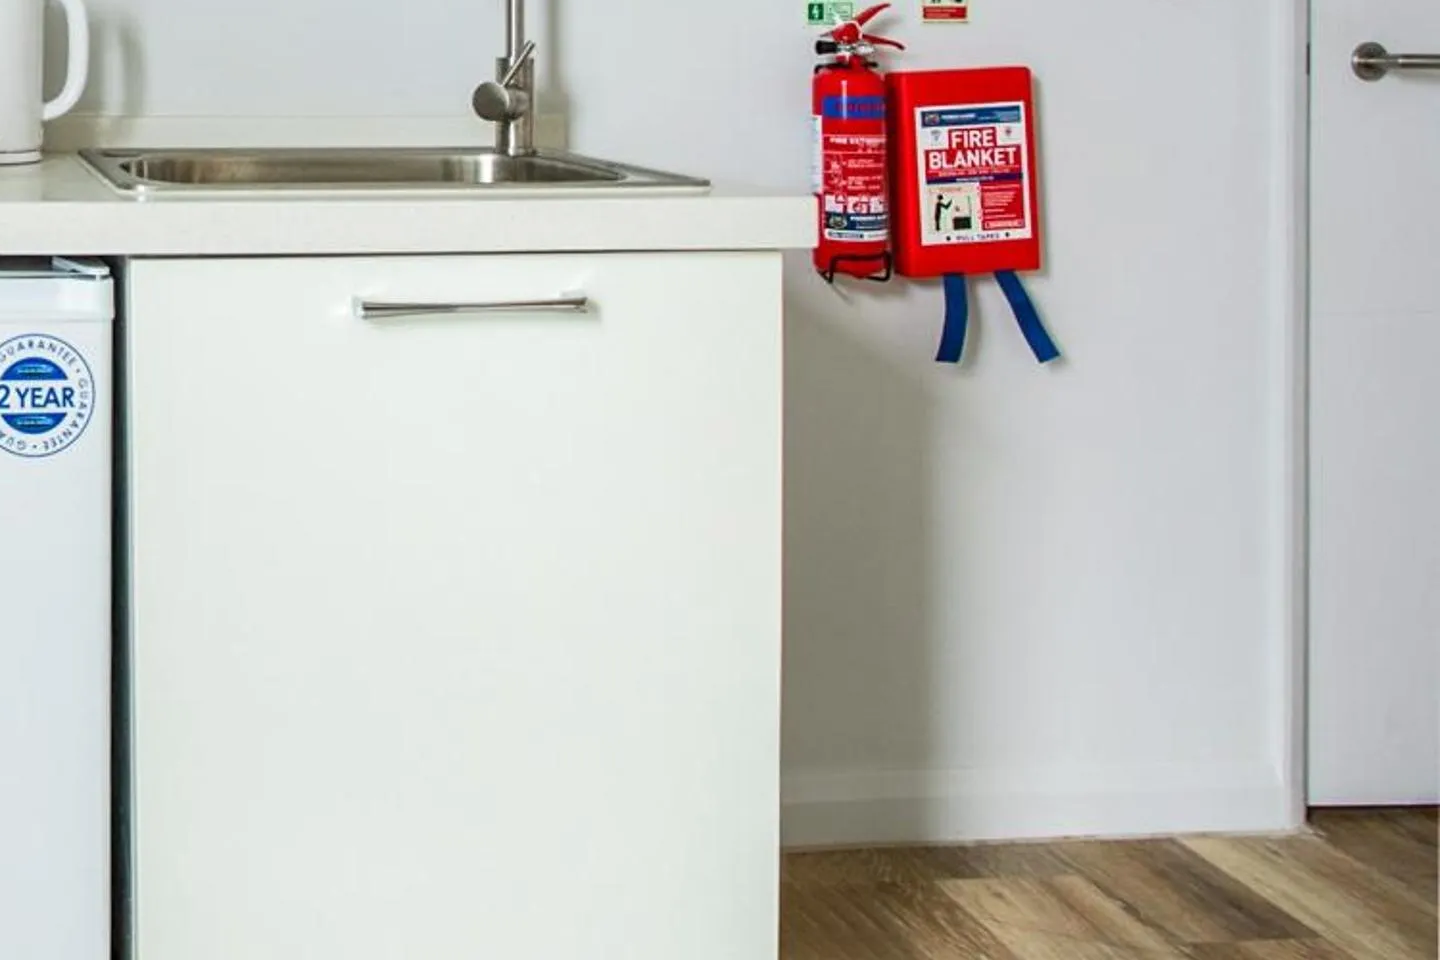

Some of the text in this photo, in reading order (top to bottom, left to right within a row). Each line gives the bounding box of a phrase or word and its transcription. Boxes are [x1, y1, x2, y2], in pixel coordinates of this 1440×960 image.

[951, 128, 995, 149] FIRE
[928, 147, 1017, 170] BLANKET
[15, 386, 76, 409] YEAR
